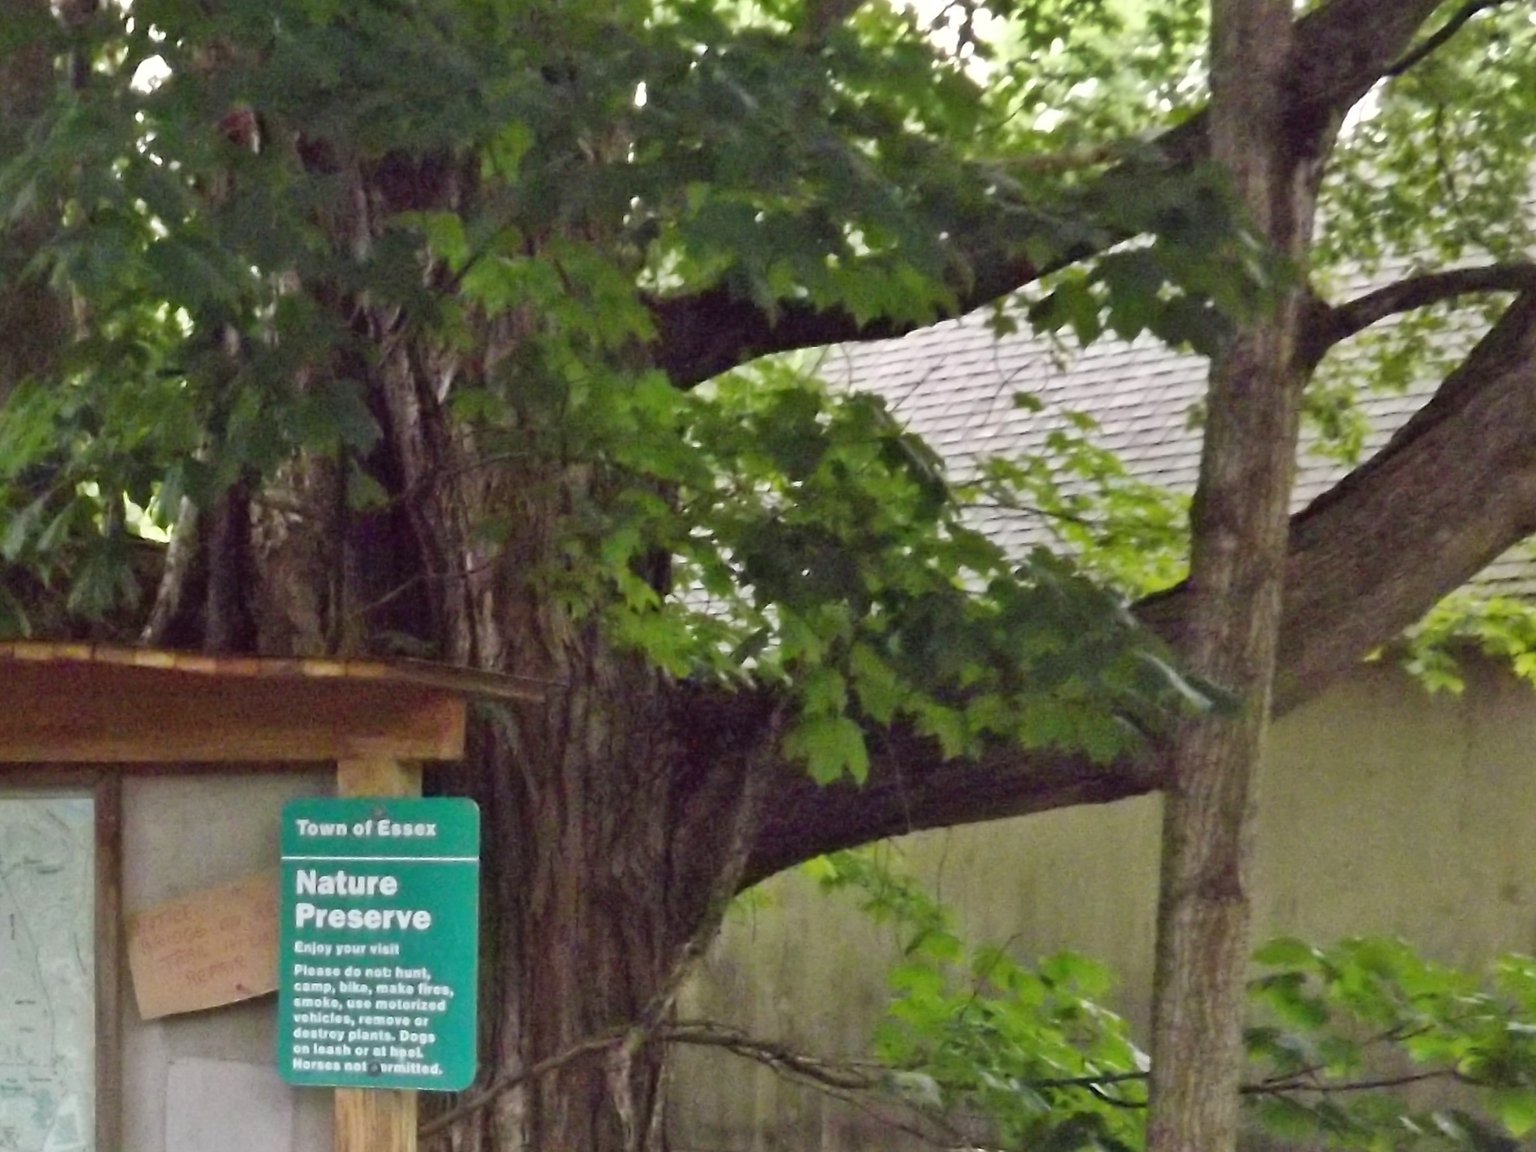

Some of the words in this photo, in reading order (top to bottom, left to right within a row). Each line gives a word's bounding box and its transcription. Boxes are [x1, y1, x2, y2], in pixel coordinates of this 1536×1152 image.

[296, 818, 348, 836] Town
[352, 819, 372, 836] of
[377, 819, 436, 837] Essex
[296, 869, 398, 896] Nature
[295, 903, 432, 930] Preserve
[294, 941, 332, 956] Enjoy
[335, 944, 366, 956] your
[369, 943, 400, 955] visit
[294, 964, 341, 977] Please
[344, 966, 362, 978] do
[395, 966, 431, 980] hunt,
[293, 982, 336, 994] camp,
[339, 982, 373, 995] bike,
[375, 983, 414, 994] make
[417, 983, 454, 998] fires,
[293, 997, 343, 1011] smoke,
[346, 999, 372, 1009] use
[375, 998, 447, 1011] motorized
[293, 1012, 355, 1026] vehicles,
[358, 1015, 410, 1026] remove
[414, 1016, 429, 1026] or
[293, 1027, 345, 1042] destroy
[348, 1029, 396, 1042] plants.
[399, 1029, 436, 1044] Dogs
[293, 1044, 310, 1054] on
[313, 1043, 351, 1056] leash
[354, 1046, 369, 1056] or
[372, 1046, 386, 1056] at
[292, 1058, 341, 1071] Horses
[344, 1060, 367, 1072] not
[368, 1061, 443, 1075] ermitted.
